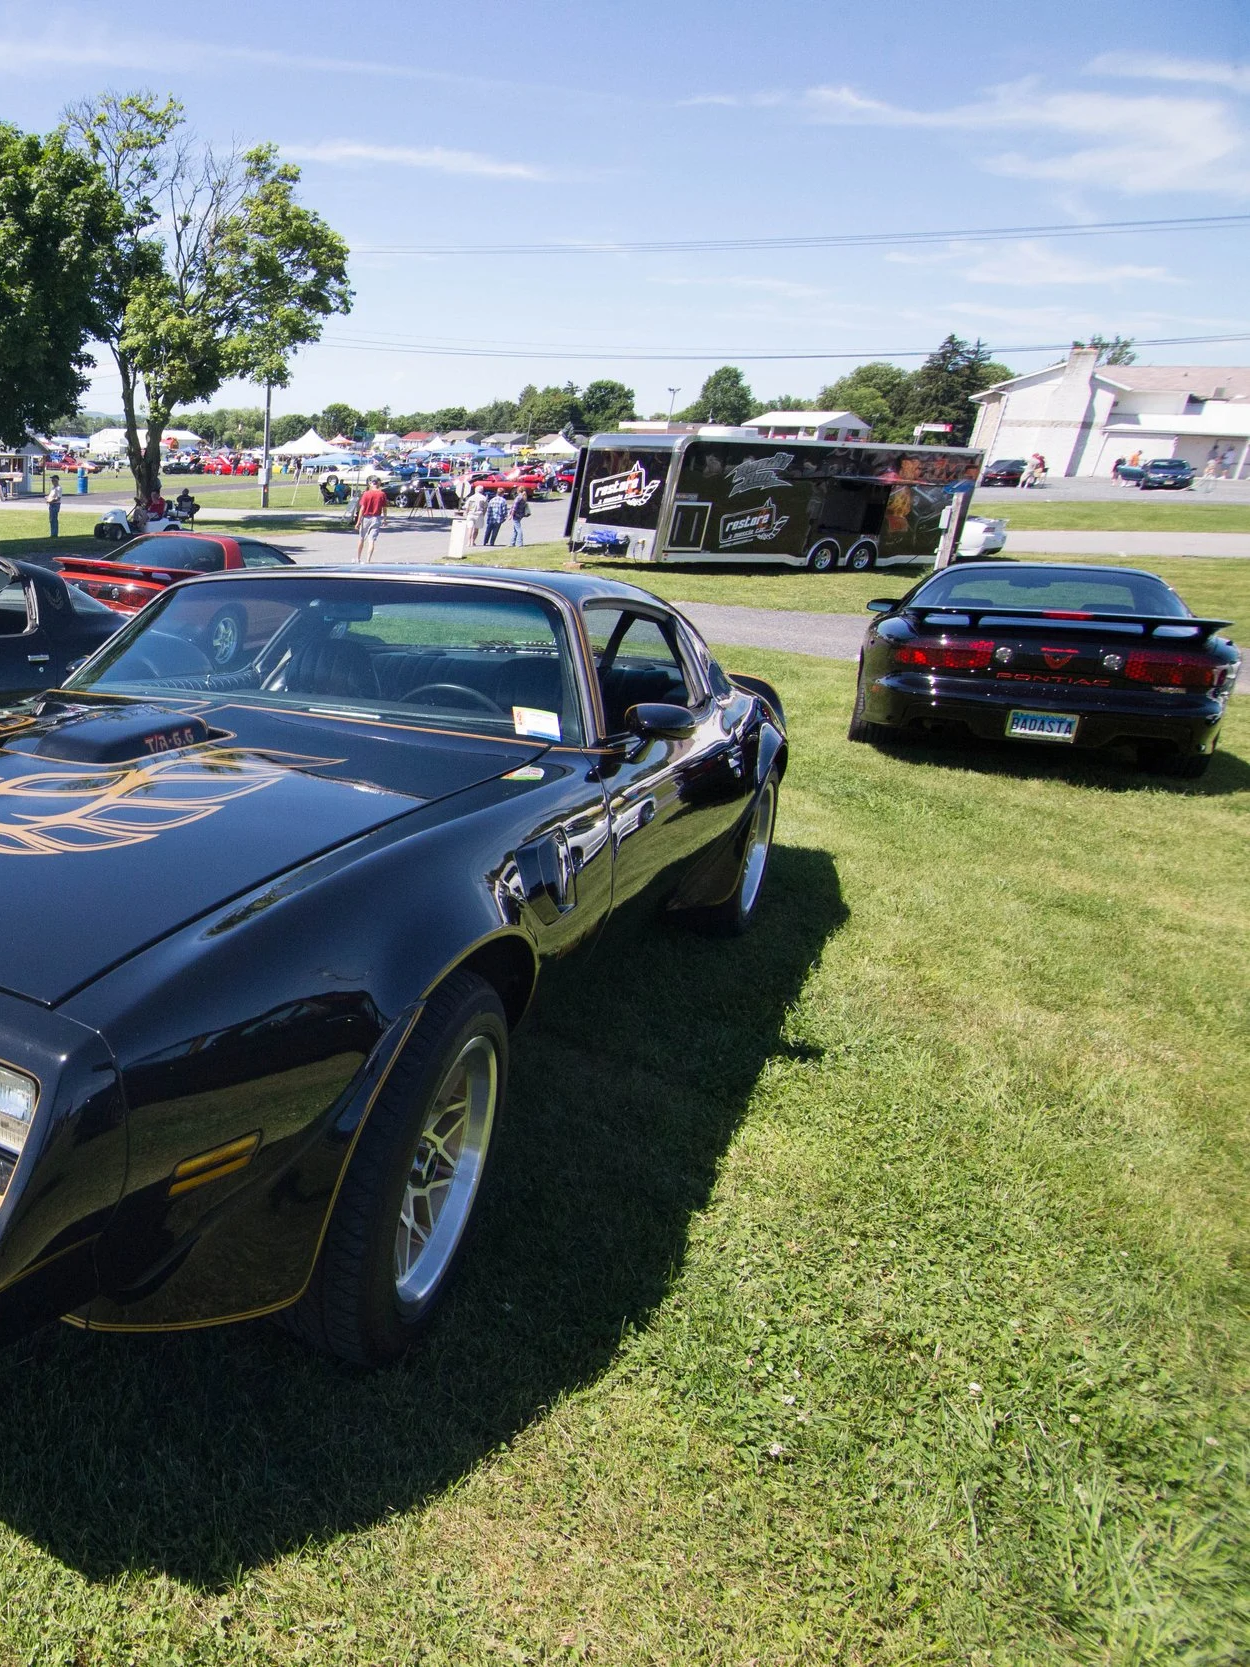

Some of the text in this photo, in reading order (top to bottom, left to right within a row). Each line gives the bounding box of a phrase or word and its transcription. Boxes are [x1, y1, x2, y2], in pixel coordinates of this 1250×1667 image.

[594, 478, 640, 498] restore
[725, 514, 771, 532] restore
[996, 672, 1111, 687] PONTIAC
[1011, 717, 1073, 735] BADASTA
